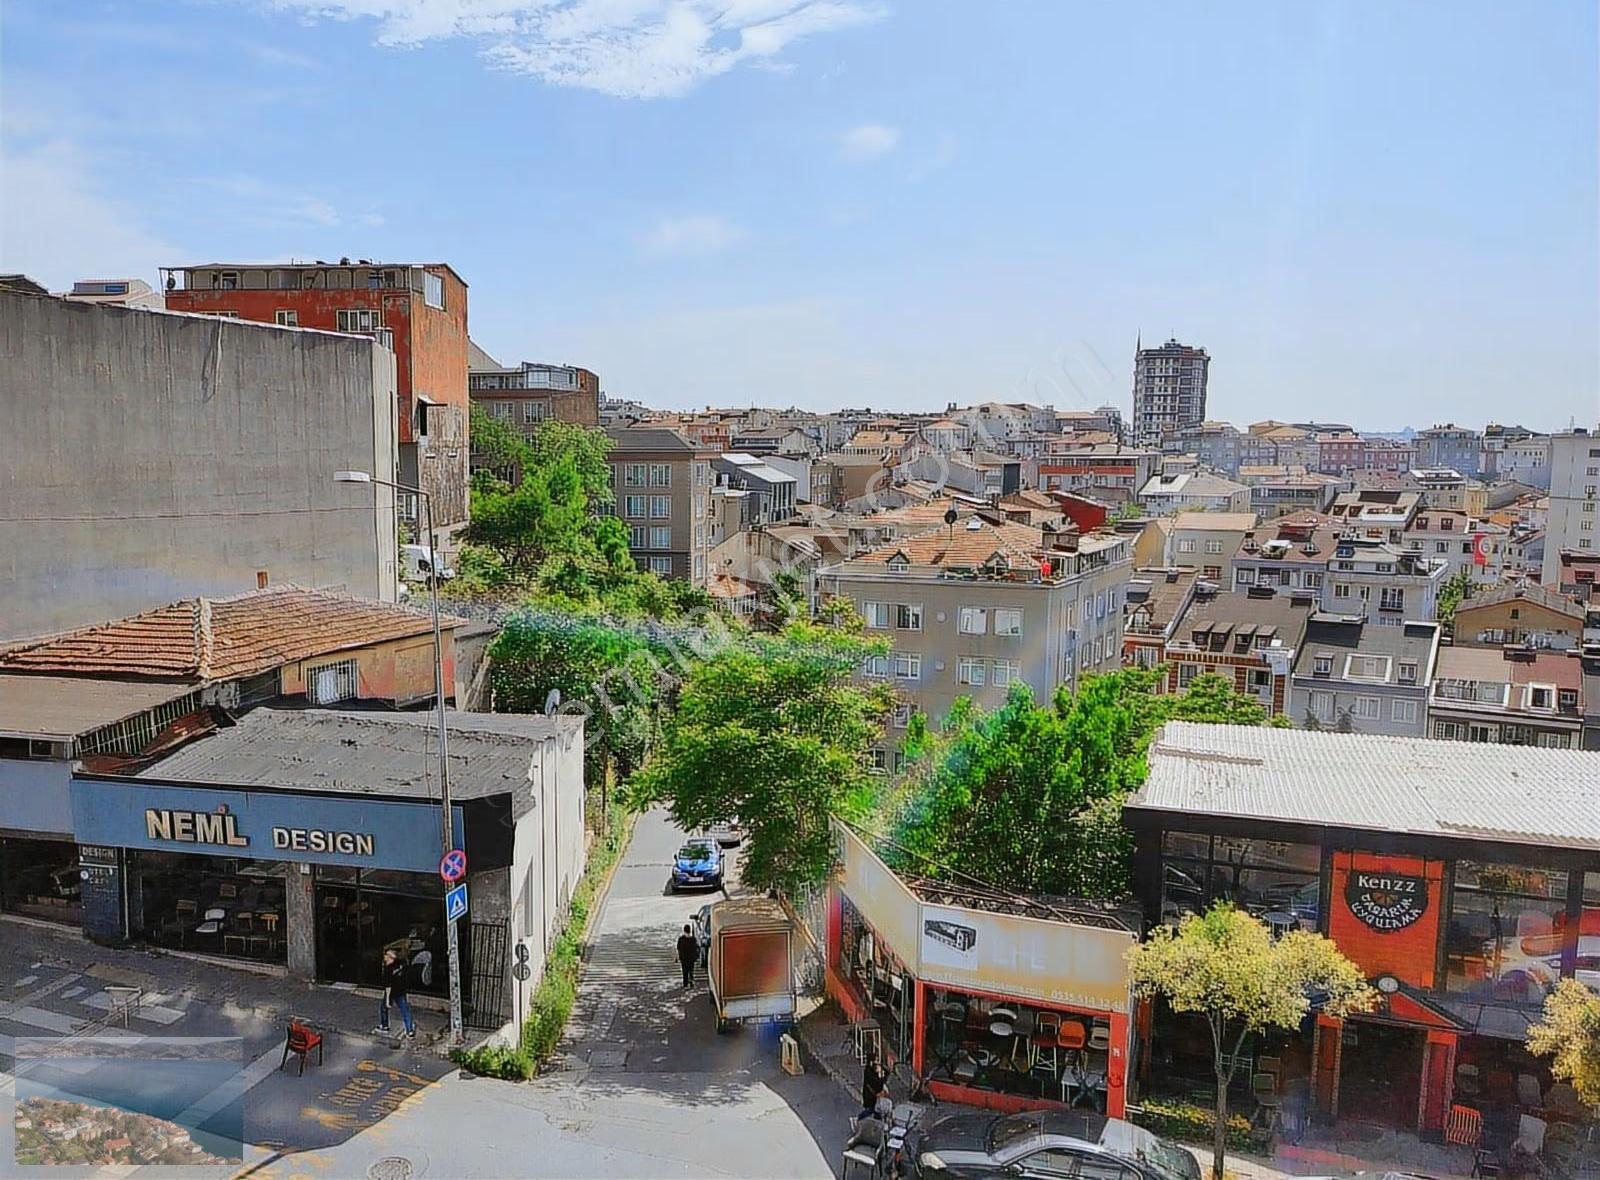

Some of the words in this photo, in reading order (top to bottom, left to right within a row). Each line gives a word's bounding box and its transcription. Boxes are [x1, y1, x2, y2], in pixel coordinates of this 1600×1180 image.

[272, 827, 373, 856] DESIGN
[82, 846, 114, 859] DESIGN
[1358, 874, 1416, 893] Kenzz
